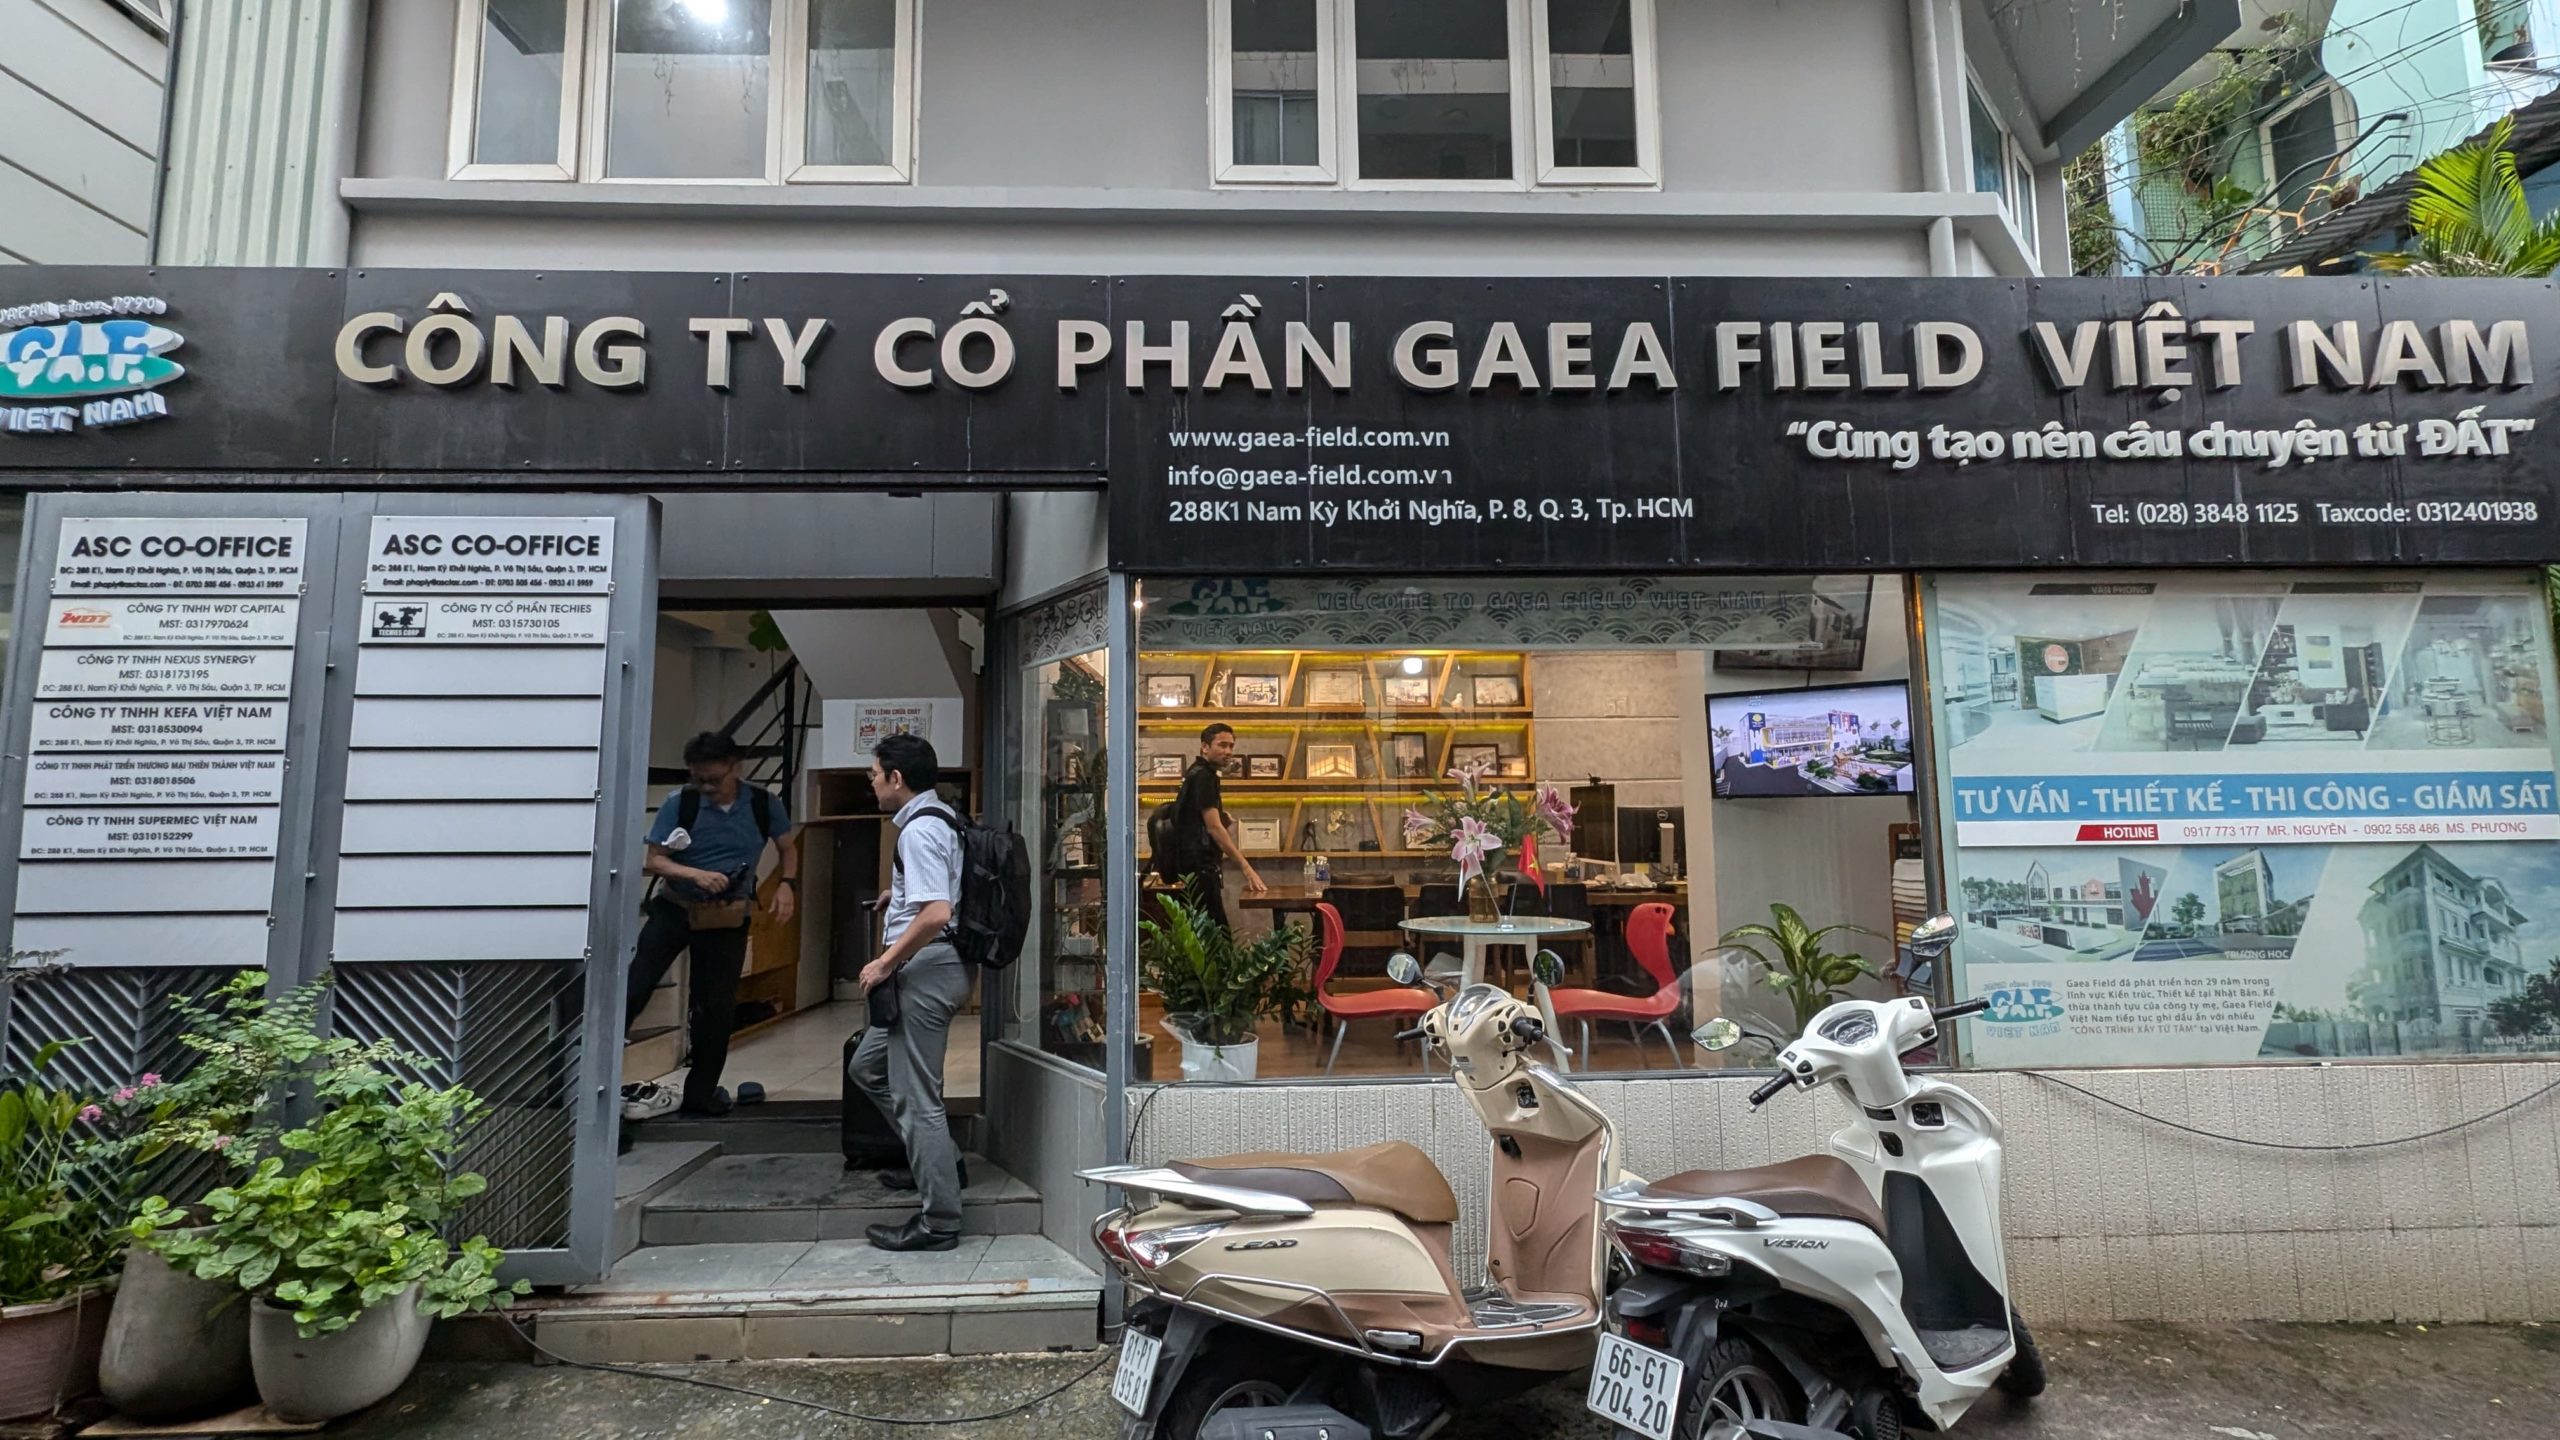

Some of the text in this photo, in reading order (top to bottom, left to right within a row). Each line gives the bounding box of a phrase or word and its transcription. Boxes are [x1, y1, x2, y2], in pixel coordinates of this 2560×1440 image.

[334, 288, 2535, 404] CÔNG TY CỔ PHẦN GAEA FIELD VIỆT NAM
[1168, 428, 1449, 450] www.gaea-field.com.vn
[1927, 423, 2004, 465] tạo
[2012, 421, 2096, 458] nên
[2103, 420, 2182, 457] câu
[2188, 419, 2348, 463] chuyện
[2352, 421, 2408, 455] từ
[1169, 501, 1238, 521] 288K1
[1247, 501, 1301, 520] Nam
[1309, 500, 1338, 527] Kỳ
[1346, 498, 1400, 520] Khởi
[1408, 499, 1482, 525] Nghĩa,
[1489, 499, 1507, 518] P.
[1513, 498, 1532, 521] 8,
[1539, 498, 1564, 520] Q.
[1570, 498, 1589, 520] 3,
[2090, 501, 2538, 524] Tel: (028) 3848 1125 Taxcode: 0312401938
[72, 536, 291, 557] ASC CO-OFFICE
[383, 534, 599, 556] ASC CO-OFFICE
[126, 602, 285, 613] CÔNG TY TNHH WDT CAPITAL
[440, 600, 591, 612] CÔNG TY CỔ PHẦN TECHIES
[158, 619, 248, 628] MST: 0317970624
[472, 619, 560, 627] MST: 0315730105
[76, 653, 256, 664] CÔNG TY TNHH NEXUS SYNERGY
[118, 669, 209, 678] MST: 0318173195
[49, 704, 272, 721] CÔNG TY TNHH KEFA VIỆT NAM
[110, 725, 202, 733] MST: 0318530094
[109, 776, 196, 784] MST: 0318018506
[1958, 779, 2551, 817] TƯ VẤN THIẾT KẾ THI CÔNG GIÁM SÁT
[45, 813, 257, 826] CÔNG TY TNHH SUPERMEC VIỆT NAM
[106, 832, 193, 840] MST: 0310152299
[2103, 826, 2155, 839] HOTLINE
[2183, 826, 2210, 836] 0917
[2214, 826, 2236, 836] 773
[2240, 826, 2259, 836] 177
[2364, 824, 2392, 834] 0902
[2394, 823, 2416, 834] 558
[2418, 823, 2440, 833] 486
[1224, 1238, 1299, 1251] LEAD
[1763, 1238, 1830, 1250] VISION
[1608, 1343, 1667, 1395] 66-G1
[1595, 1375, 1668, 1434] 704.20
